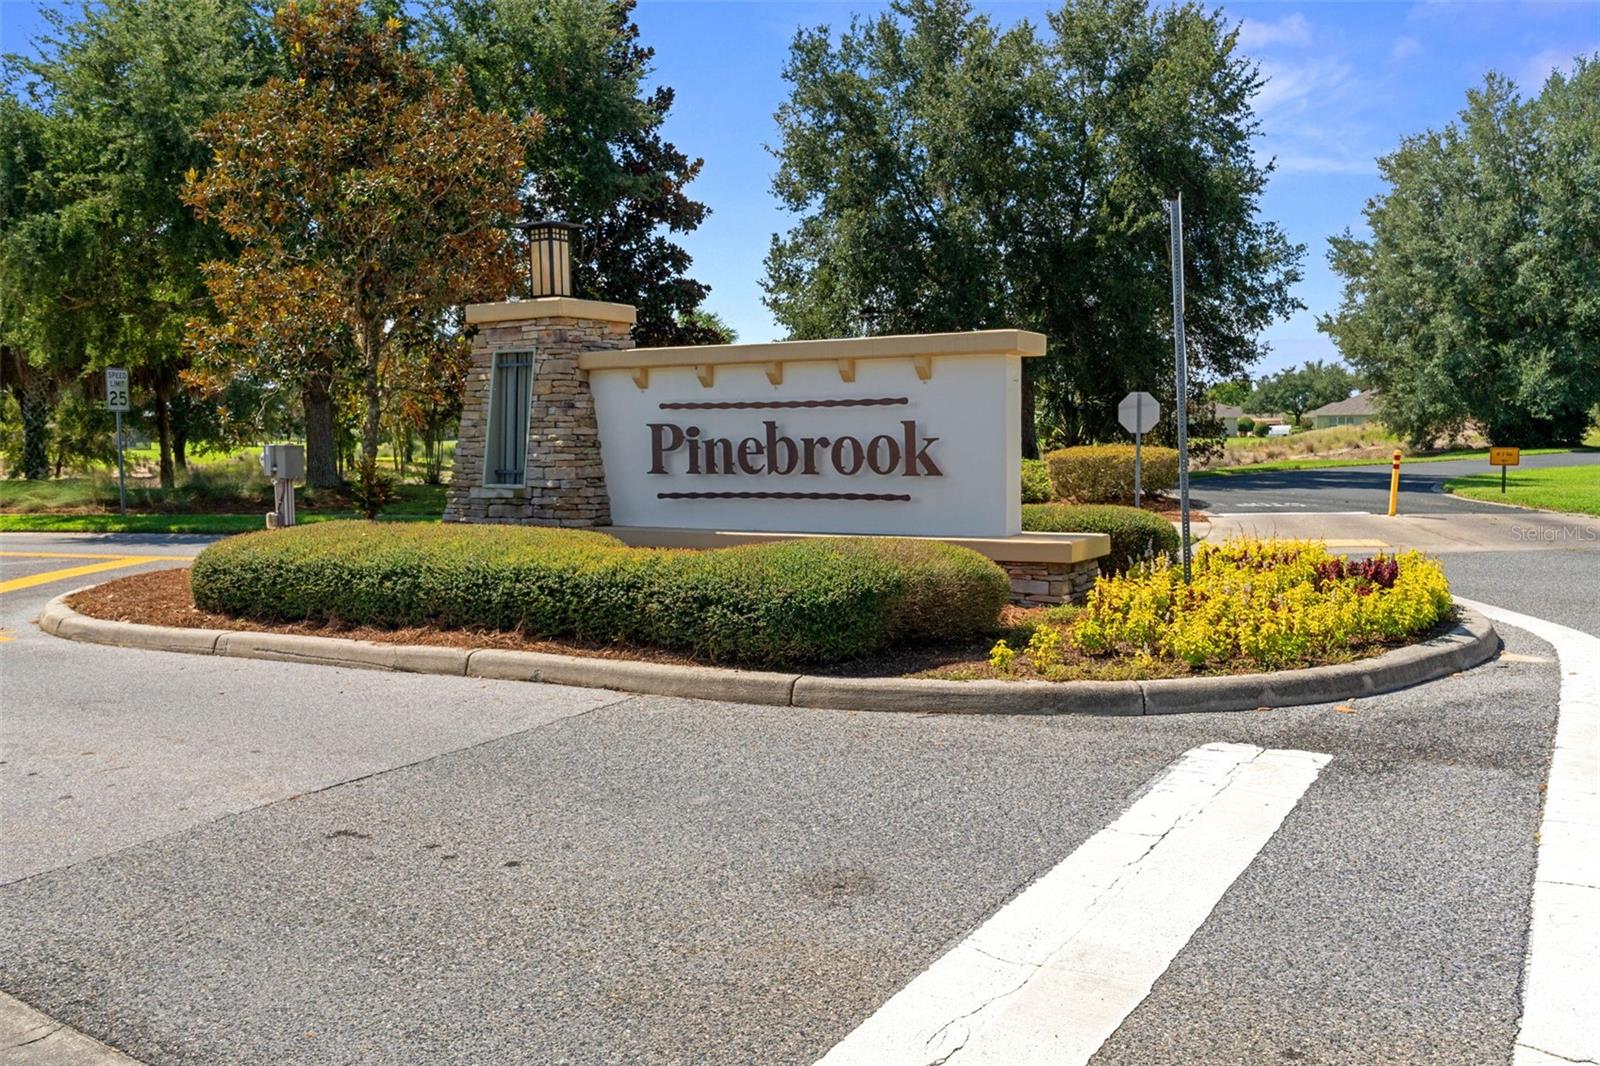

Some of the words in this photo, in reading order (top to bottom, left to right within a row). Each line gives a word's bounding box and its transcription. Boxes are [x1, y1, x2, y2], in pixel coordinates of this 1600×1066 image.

[108, 371, 128, 379] SPEED
[110, 391, 128, 406] 25
[646, 420, 943, 477] Pinebrook
